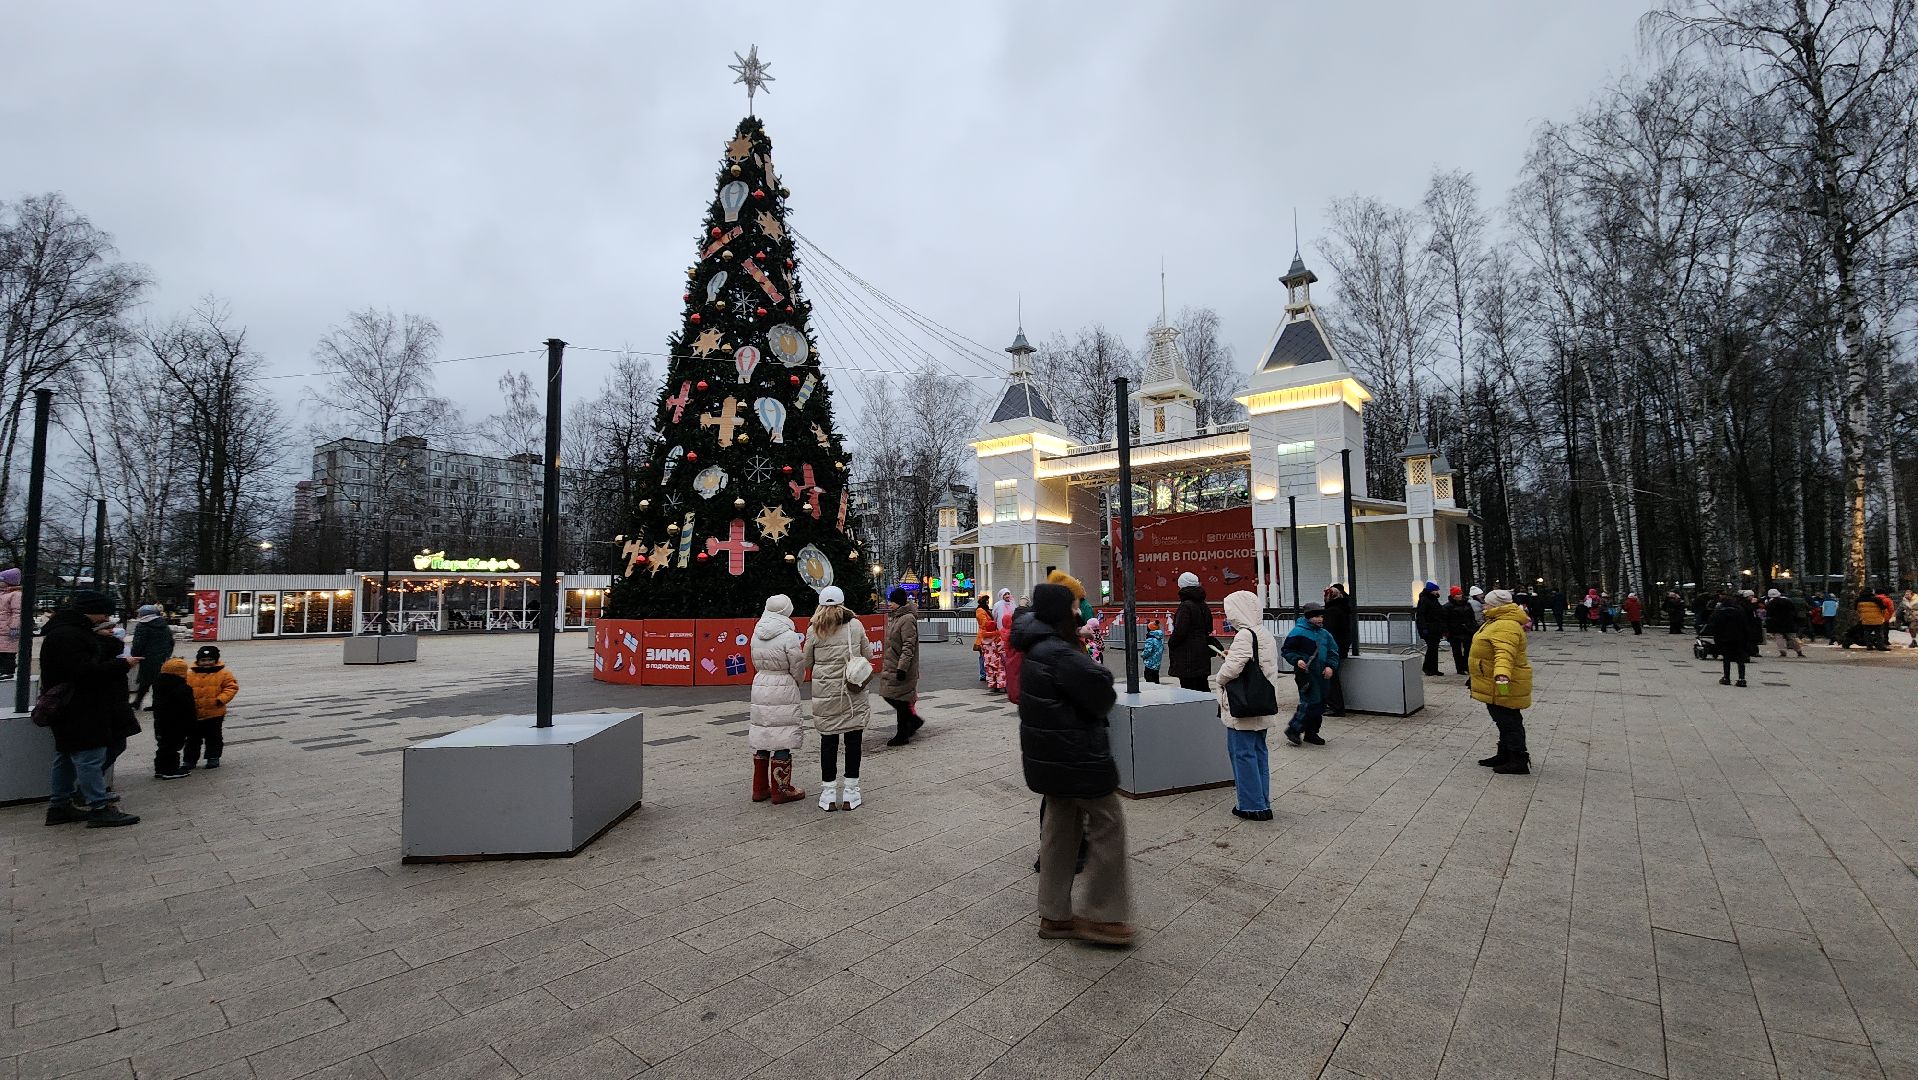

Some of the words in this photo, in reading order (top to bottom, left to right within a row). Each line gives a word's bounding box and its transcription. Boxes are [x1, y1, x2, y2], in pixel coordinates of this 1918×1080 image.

[1138, 552, 1170, 563] ЗИМА
[1173, 551, 1181, 561] В
[1183, 548, 1268, 561] ПОДМОСКОВ
[646, 648, 691, 661] ЗИМА
